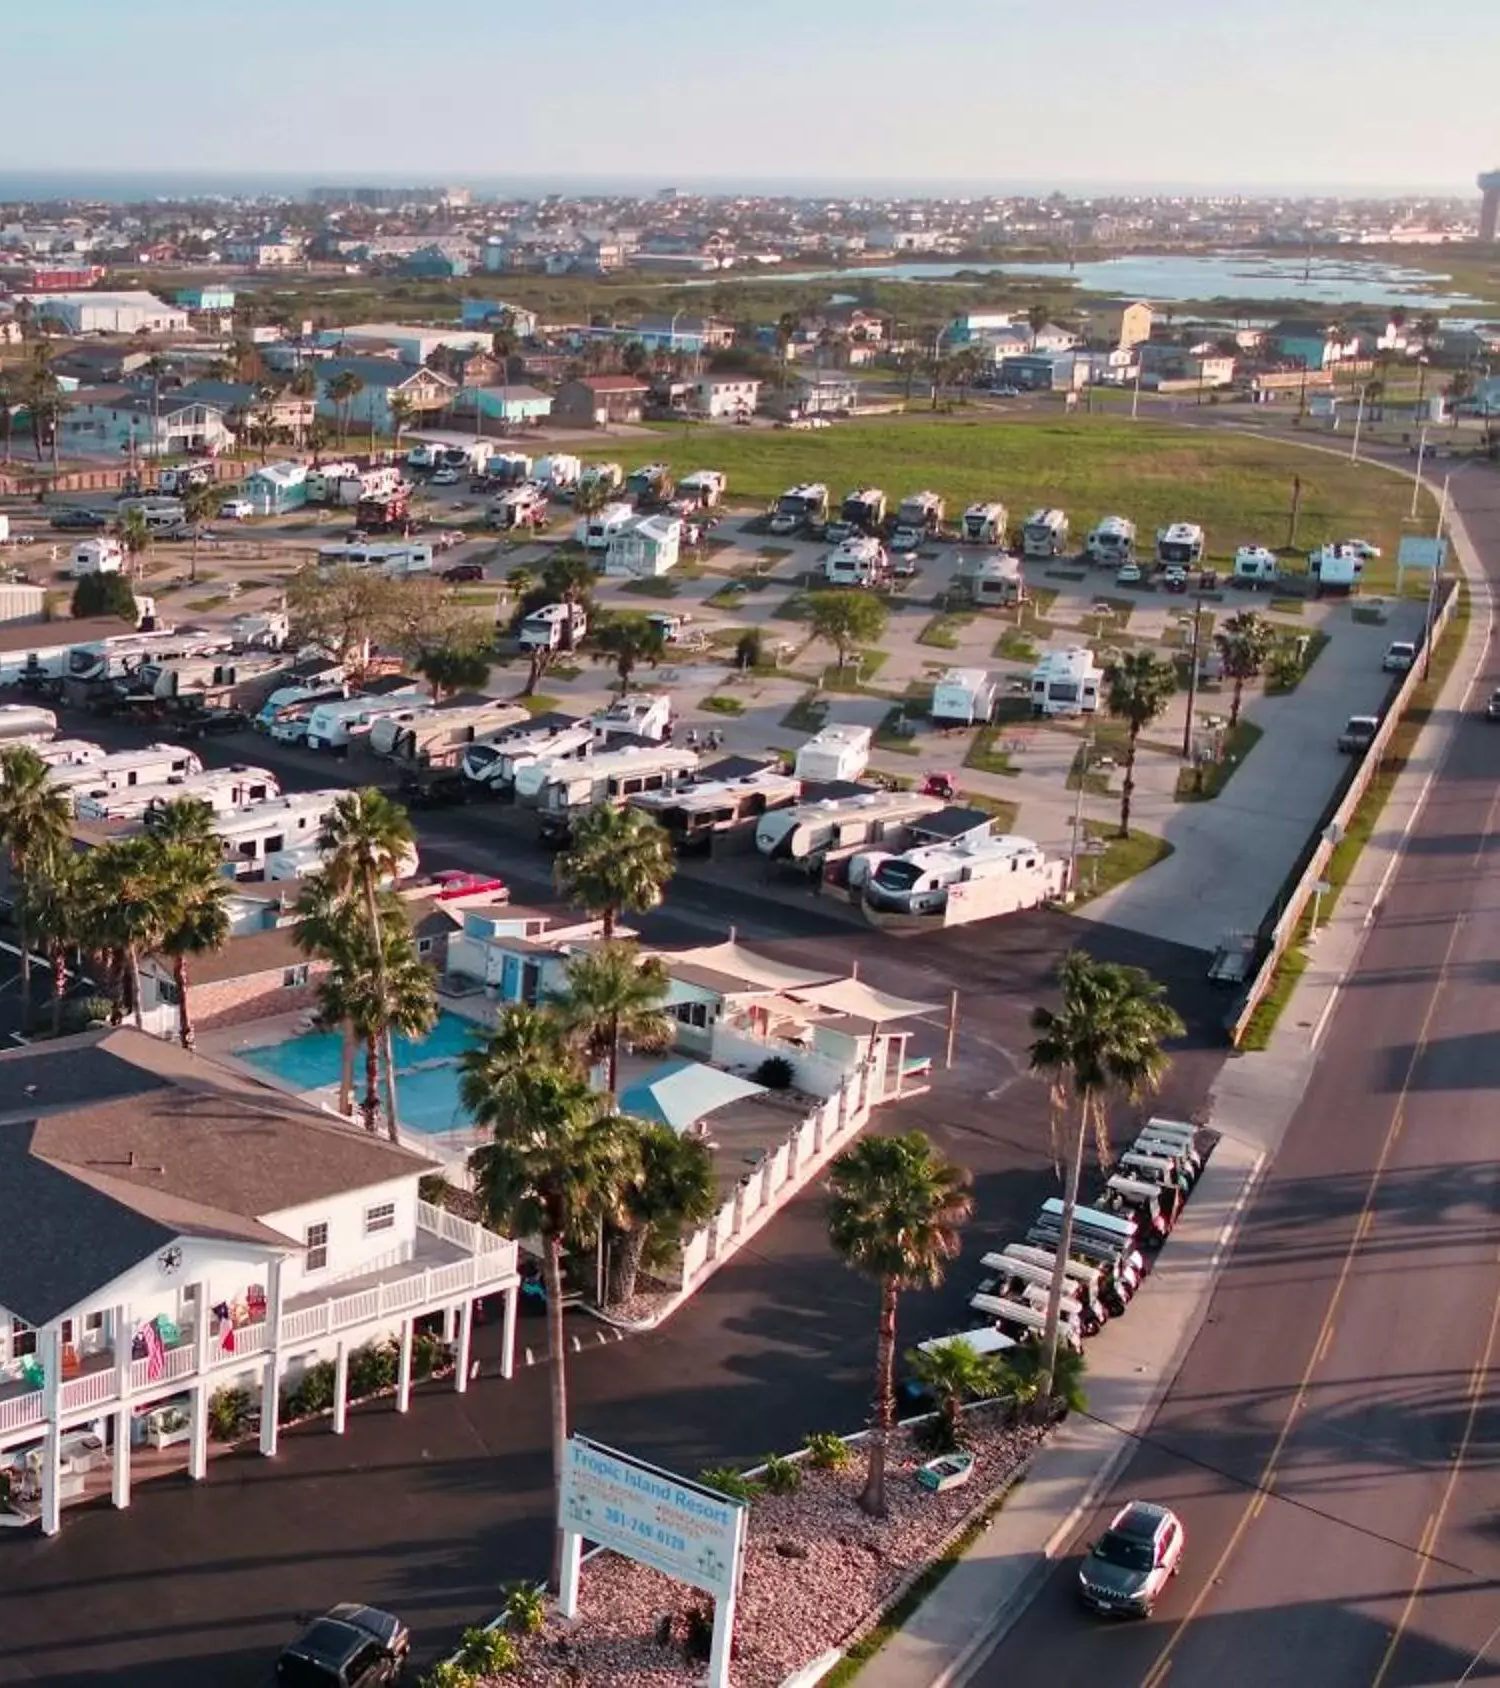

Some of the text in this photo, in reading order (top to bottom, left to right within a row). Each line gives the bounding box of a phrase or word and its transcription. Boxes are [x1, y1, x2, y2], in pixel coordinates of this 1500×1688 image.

[574, 1449, 619, 1480] Tropic
[625, 1469, 670, 1500] Island
[676, 1491, 729, 1525] Resort
